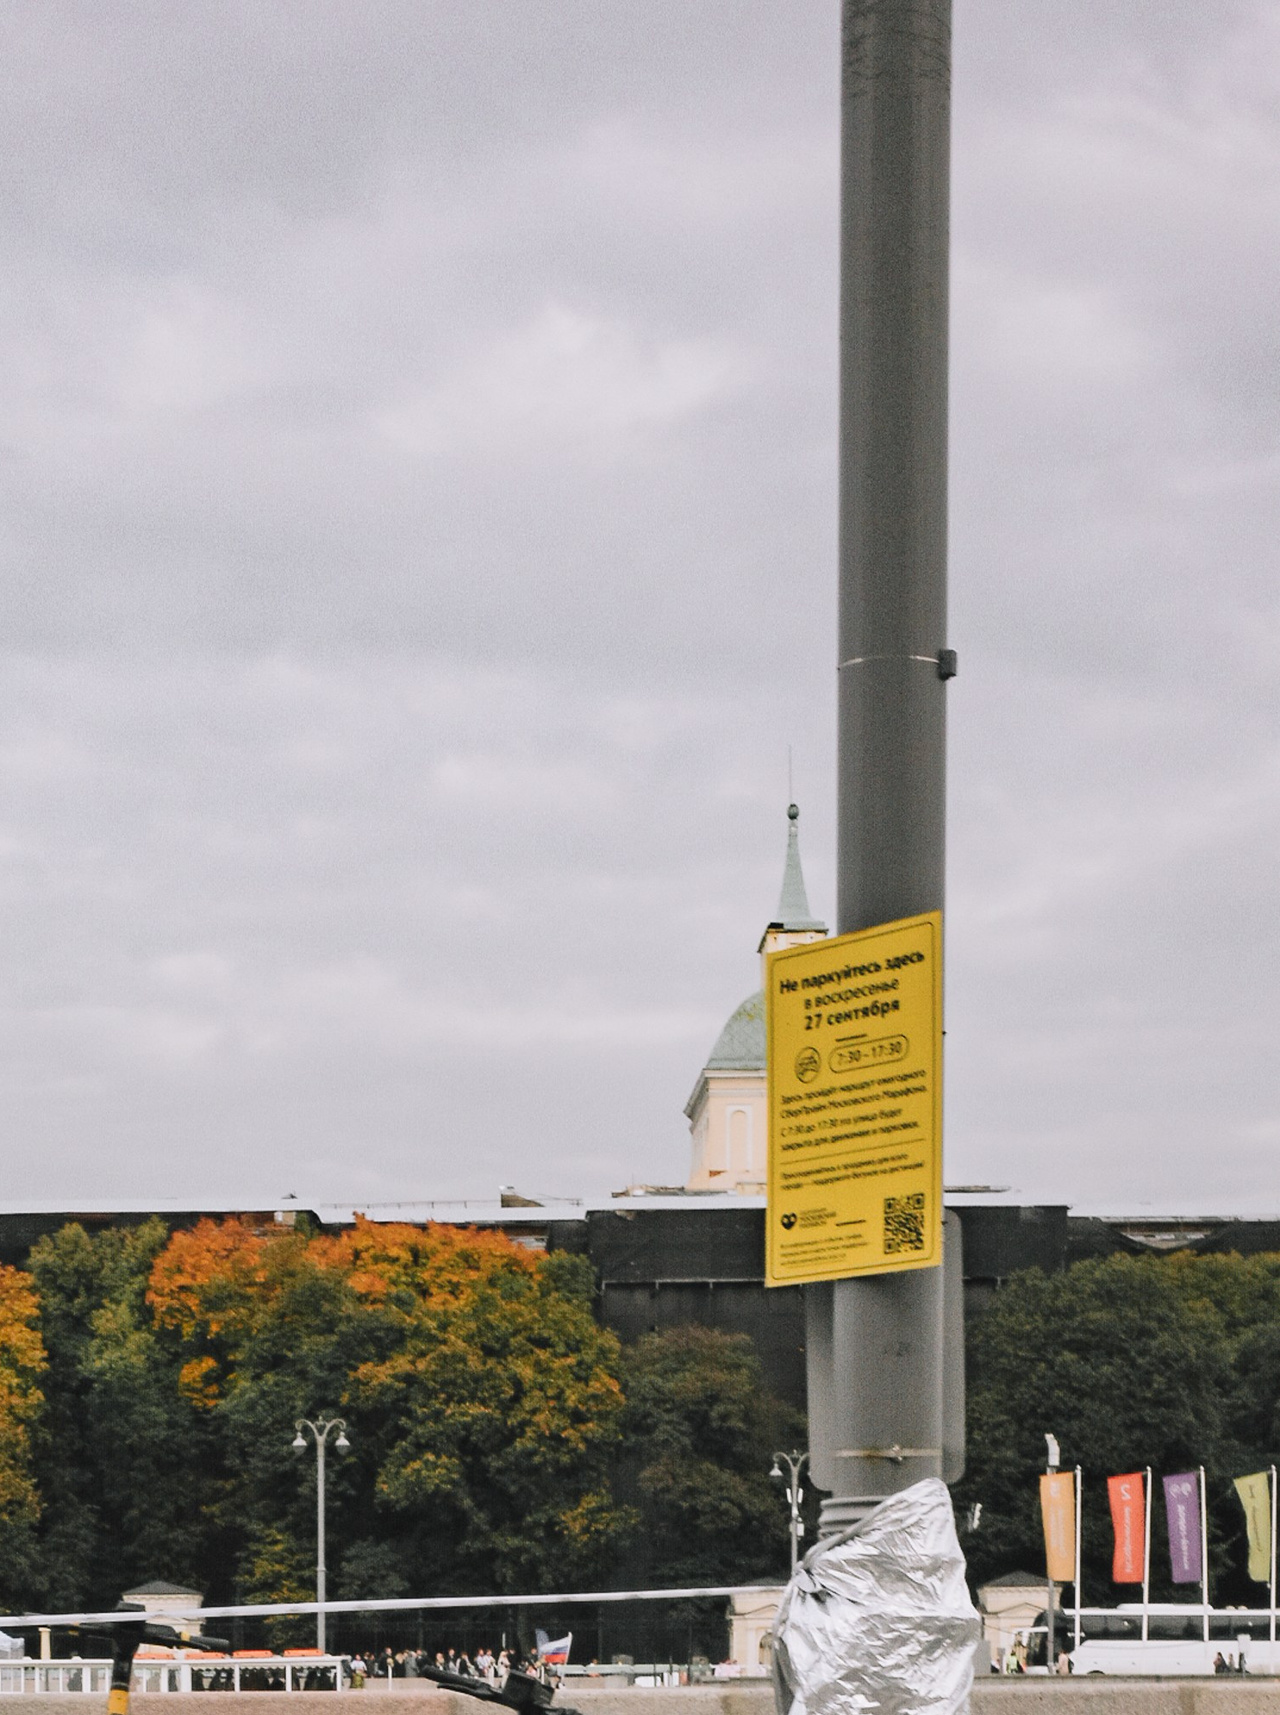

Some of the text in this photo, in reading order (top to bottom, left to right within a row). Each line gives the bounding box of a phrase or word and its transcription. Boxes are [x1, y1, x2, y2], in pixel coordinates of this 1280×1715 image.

[780, 951, 925, 994] Не паркуйтесь здесь
[804, 979, 900, 1010] в воскресенье
[804, 999, 900, 1030] 27 сентября
[871, 1041, 903, 1059] 17:30
